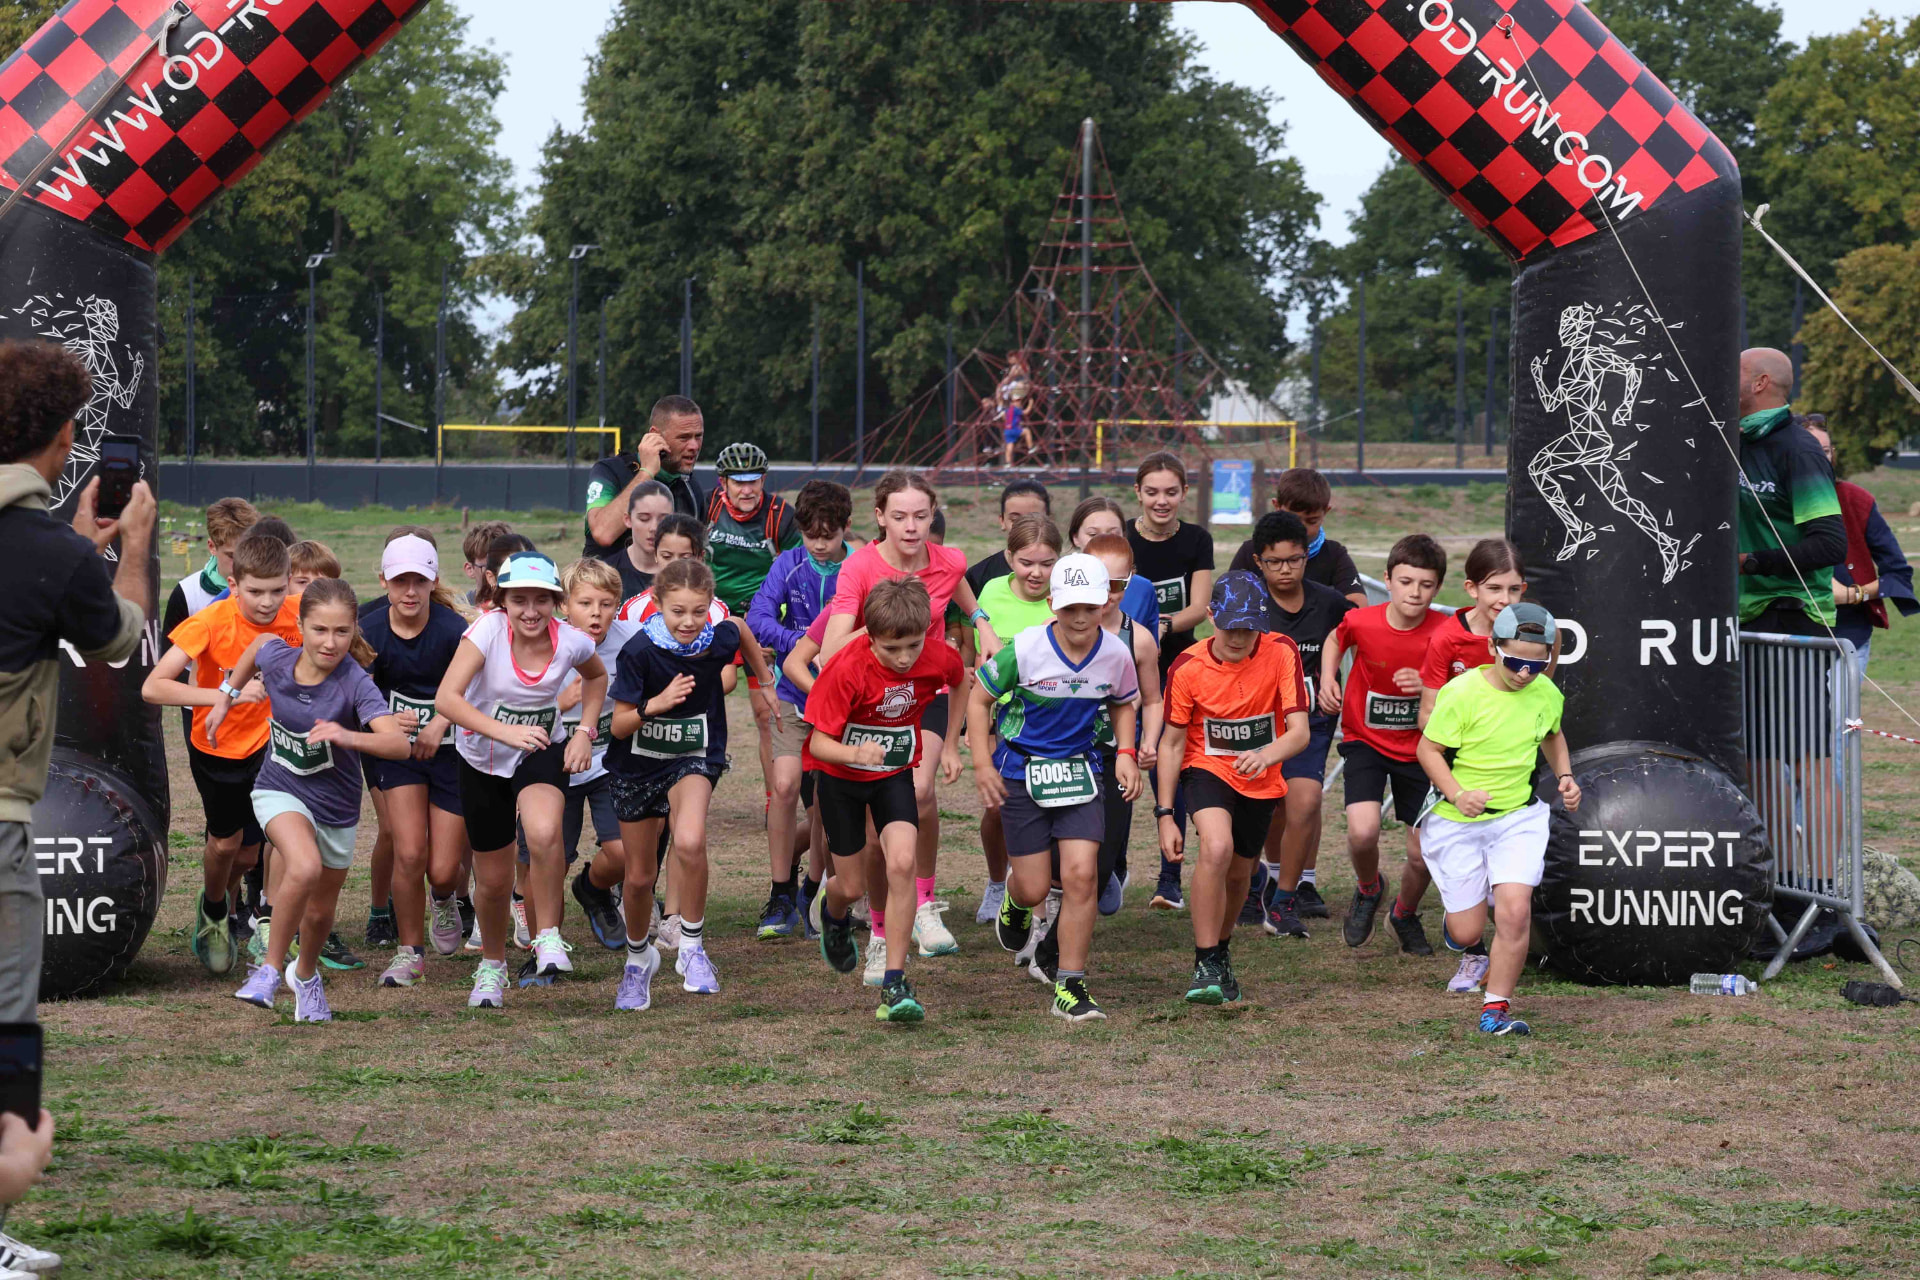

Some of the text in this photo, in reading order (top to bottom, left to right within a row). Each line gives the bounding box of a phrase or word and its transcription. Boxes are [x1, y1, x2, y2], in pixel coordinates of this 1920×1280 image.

[36, 0, 284, 202] WWW.OD-R
[1064, 567, 1089, 586] LA
[1302, 643, 1320, 652] Hat
[1640, 616, 1740, 666] RUN
[1373, 700, 1410, 715] 5013
[273, 727, 305, 758] 5016
[641, 721, 683, 743] 5015
[1211, 724, 1251, 741] 5019
[1031, 762, 1073, 786] 5005
[1579, 830, 1741, 867] EXPERT
[1570, 888, 1744, 926] RUNNING
